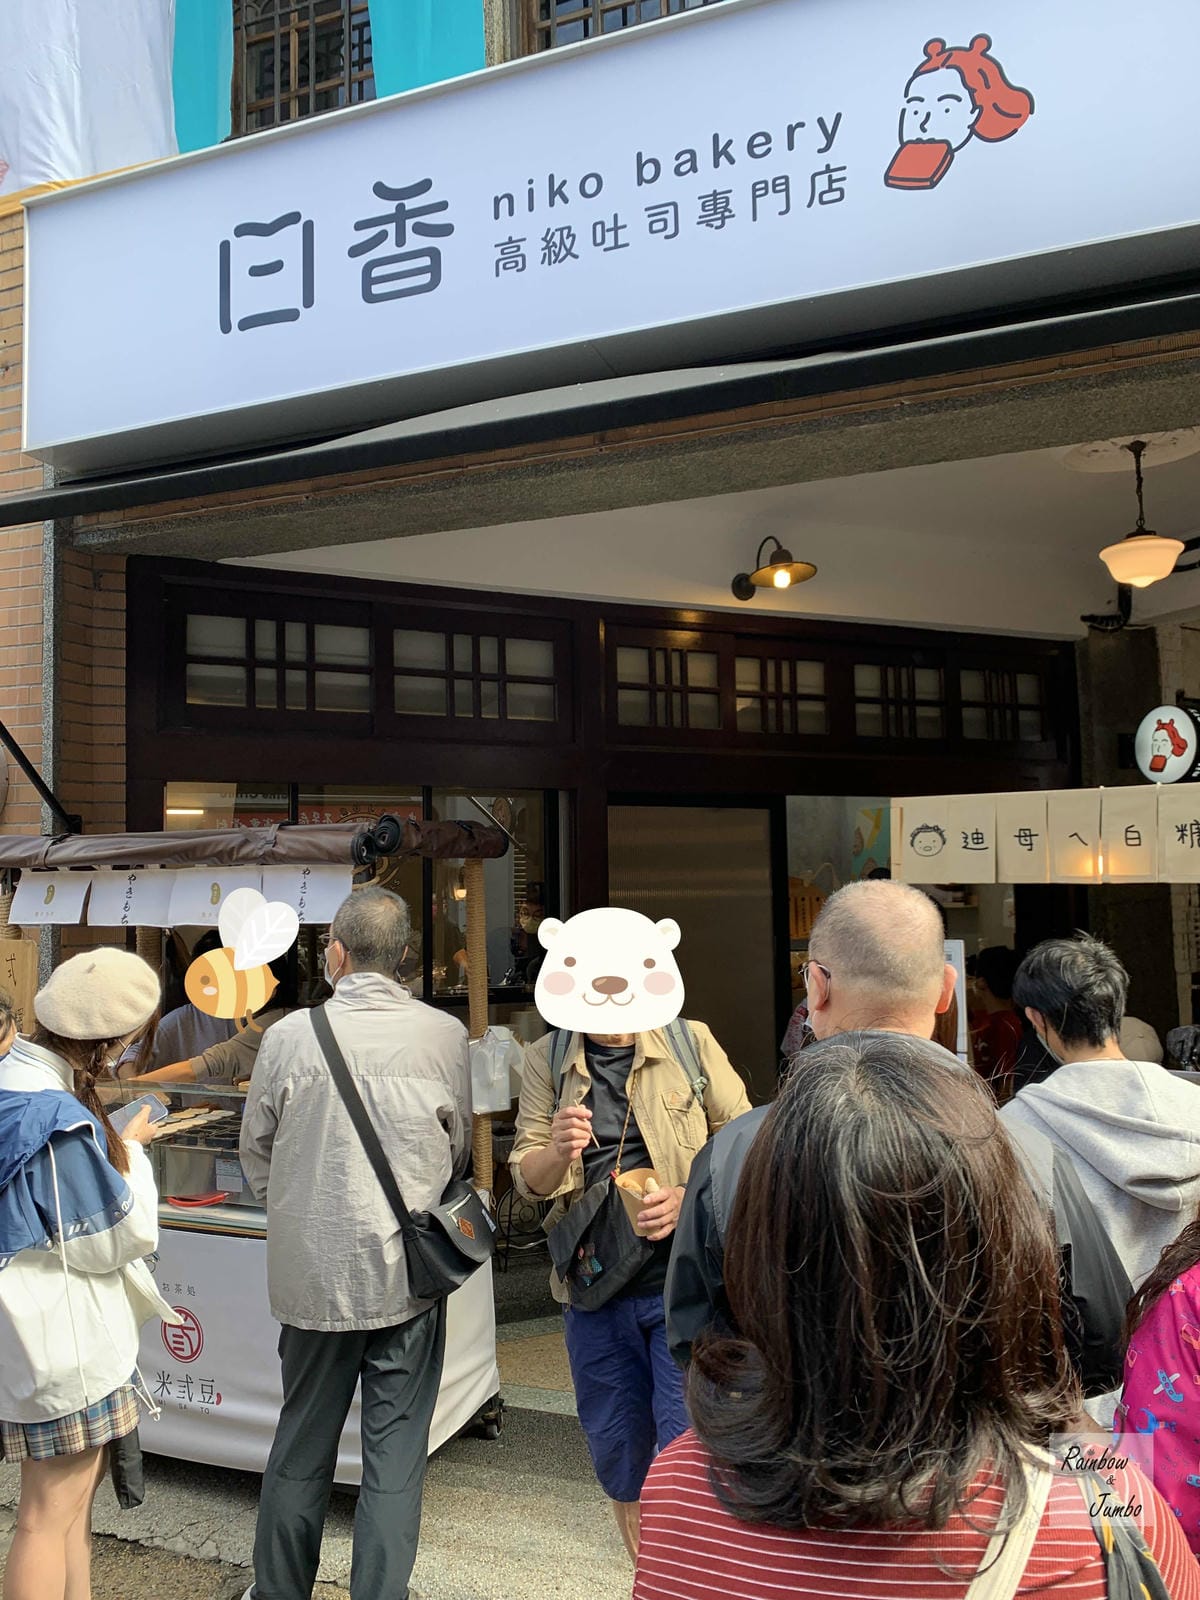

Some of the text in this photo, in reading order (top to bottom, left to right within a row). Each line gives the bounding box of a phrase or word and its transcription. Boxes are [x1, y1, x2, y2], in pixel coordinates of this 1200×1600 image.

[493, 112, 843, 220] niko bakery
[493, 163, 848, 278] 高級吐司專門店
